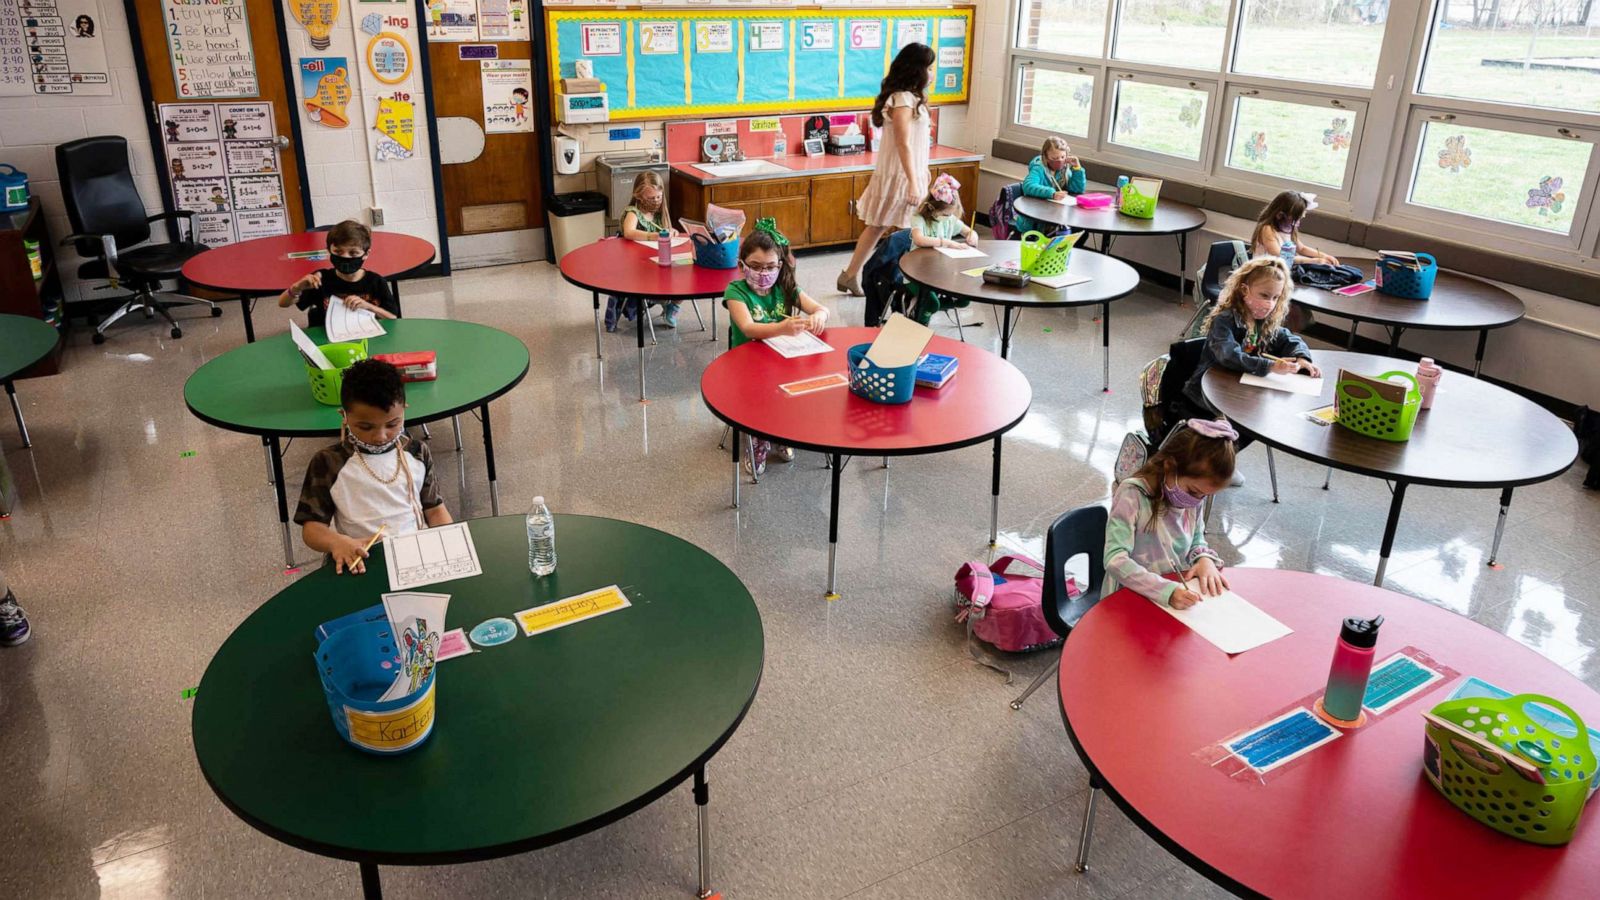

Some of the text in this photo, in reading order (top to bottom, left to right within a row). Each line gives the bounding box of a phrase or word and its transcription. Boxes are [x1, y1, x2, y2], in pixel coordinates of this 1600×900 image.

[169, 6, 243, 26] 1. try your BEST
[384, 16, 409, 28] -ing
[185, 26, 201, 36] Be
[204, 23, 231, 36] kind
[698, 26, 710, 49] 3
[752, 26, 762, 48] 4
[804, 26, 814, 47] 5
[852, 25, 862, 46] 6
[174, 39, 185, 51] 3.
[187, 40, 203, 51] Be
[642, 27, 655, 51] 2
[175, 53, 188, 66] 4.
[187, 56, 204, 64] Use
[223, 51, 251, 63] control
[303, 60, 325, 71] -ell
[179, 69, 190, 81] 5.
[190, 68, 225, 80] Follow
[181, 83, 193, 96] 6.
[389, 92, 411, 101] -ite
[555, 598, 598, 616] Karter
[378, 707, 432, 742] Karter
